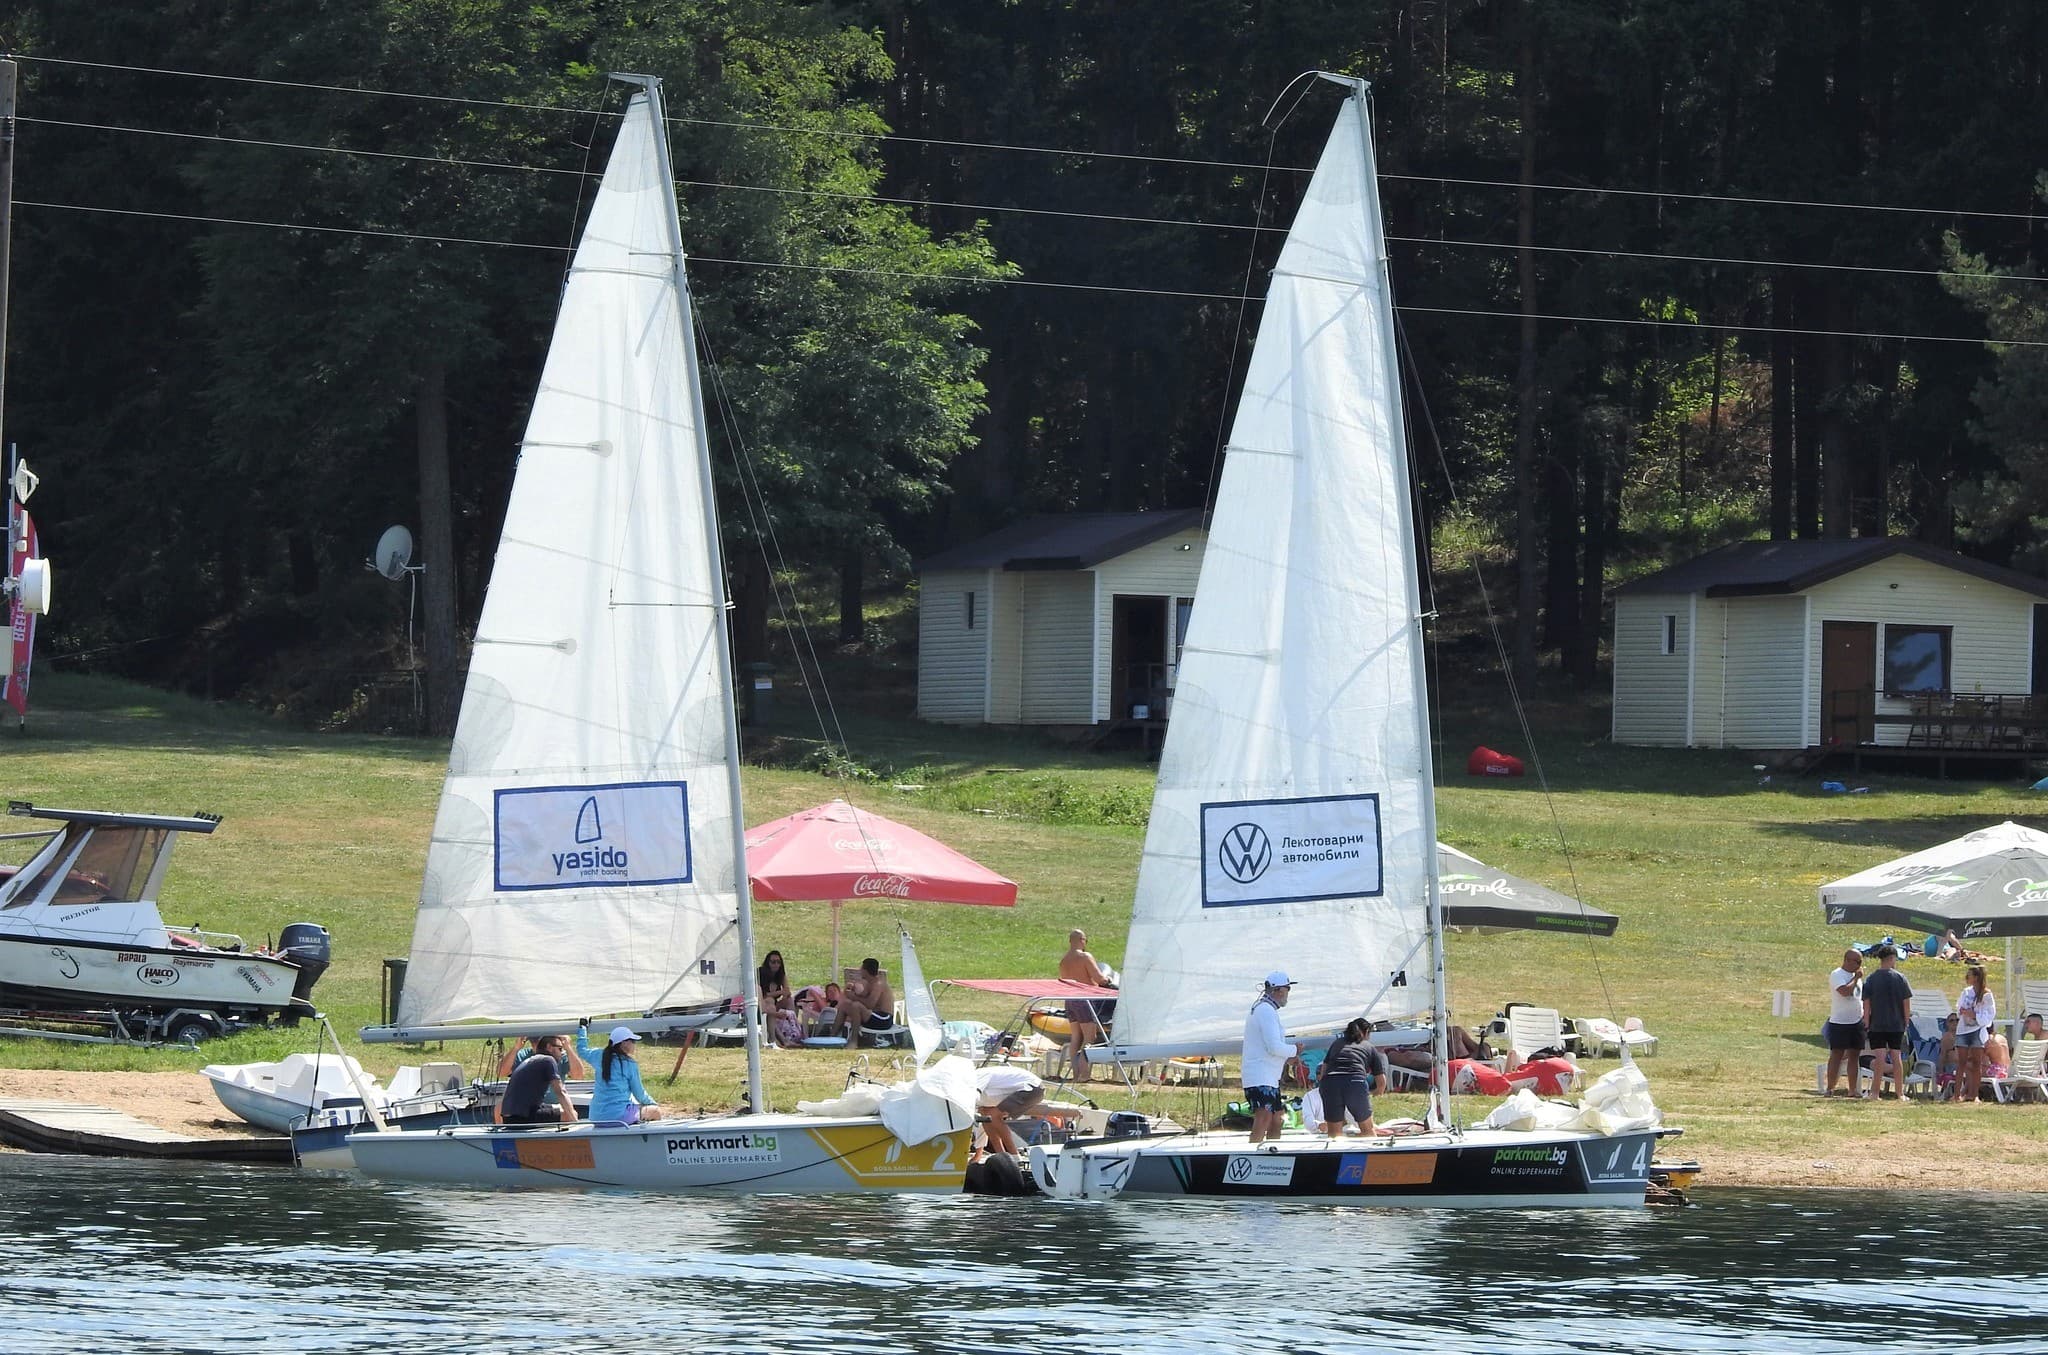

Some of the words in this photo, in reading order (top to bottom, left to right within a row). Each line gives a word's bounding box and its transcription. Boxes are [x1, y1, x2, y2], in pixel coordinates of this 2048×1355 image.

[1281, 833, 1364, 849] Лекотоварни
[552, 846, 627, 875] yasido
[1282, 849, 1359, 863] автомобили
[580, 868, 598, 877] yacht
[601, 867, 628, 877] booking
[60, 905, 102, 923] PREDATOR
[298, 936, 321, 944] YAMAHA
[172, 959, 215, 969] Raymarine
[144, 967, 174, 978] HALCO
[667, 1133, 778, 1154] parkmart.bg
[669, 1156, 705, 1165] ONLINE
[709, 1154, 779, 1164] SUPERMARKET
[931, 1136, 955, 1171] 2
[1493, 1147, 1567, 1165] parkmart.bg
[1631, 1142, 1647, 1177] 4
[1490, 1166, 1517, 1176] ONLINE
[1518, 1166, 1563, 1176] SUPERMARKET
